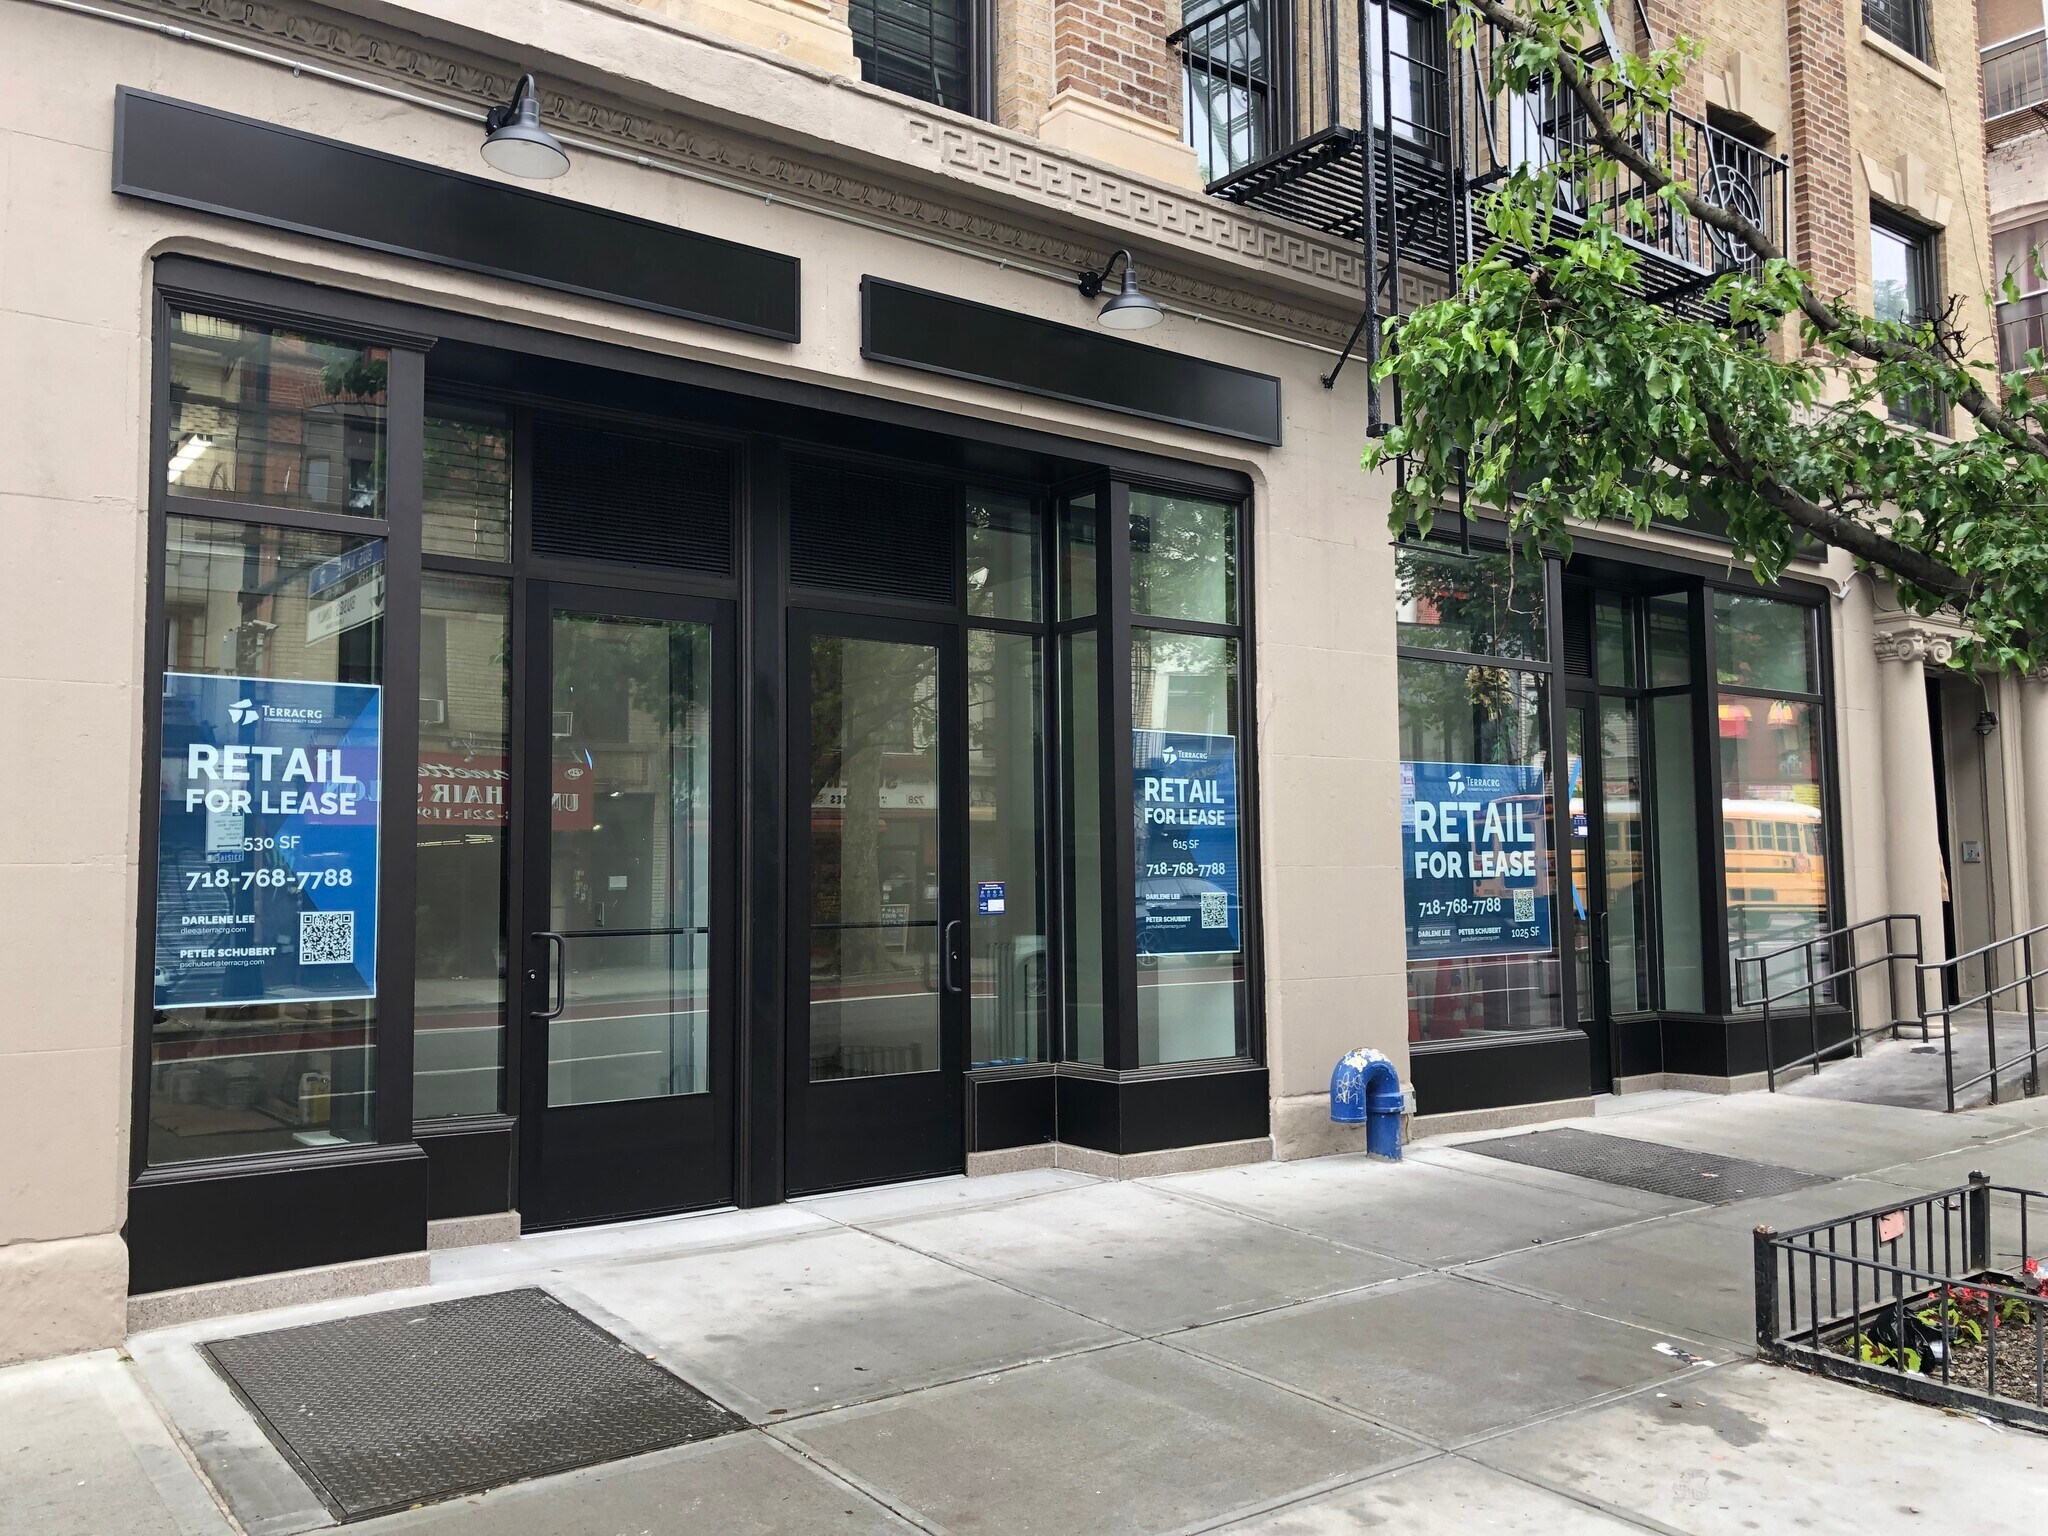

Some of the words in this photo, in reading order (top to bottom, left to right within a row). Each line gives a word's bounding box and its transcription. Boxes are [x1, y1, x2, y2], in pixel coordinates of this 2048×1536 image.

[188, 743, 357, 783] RETAIL
[1144, 777, 1224, 804] RETAIL
[186, 789, 252, 814] FOR
[261, 790, 357, 815] LEASE
[1144, 808, 1176, 825] FOR
[1179, 808, 1225, 826] LEASE
[1414, 801, 1535, 843] RETAIL
[243, 836, 274, 852] 530
[279, 835, 300, 849] SF
[1172, 840, 1188, 850] 615
[1189, 839, 1199, 849] SF
[1146, 862, 1225, 877] 718-768-7788
[1415, 851, 1463, 879] FOR
[1468, 850, 1536, 878] LEASE
[186, 868, 352, 891] 718-768-7788
[1419, 897, 1501, 918] 718-768-7788
[181, 915, 234, 925] DARLENE
[235, 914, 255, 924] LEE
[1418, 930, 1441, 938] DARLENE
[1442, 929, 1451, 937] LEE
[1458, 928, 1474, 936] PETER
[1475, 926, 1502, 935] SCHUBERT
[1511, 928, 1529, 939] 1025
[1530, 926, 1540, 936] SF
[179, 948, 216, 959] PETER
[217, 947, 277, 957] SCHUBERT
[179, 959, 265, 969] pschubert@terracrg.com
